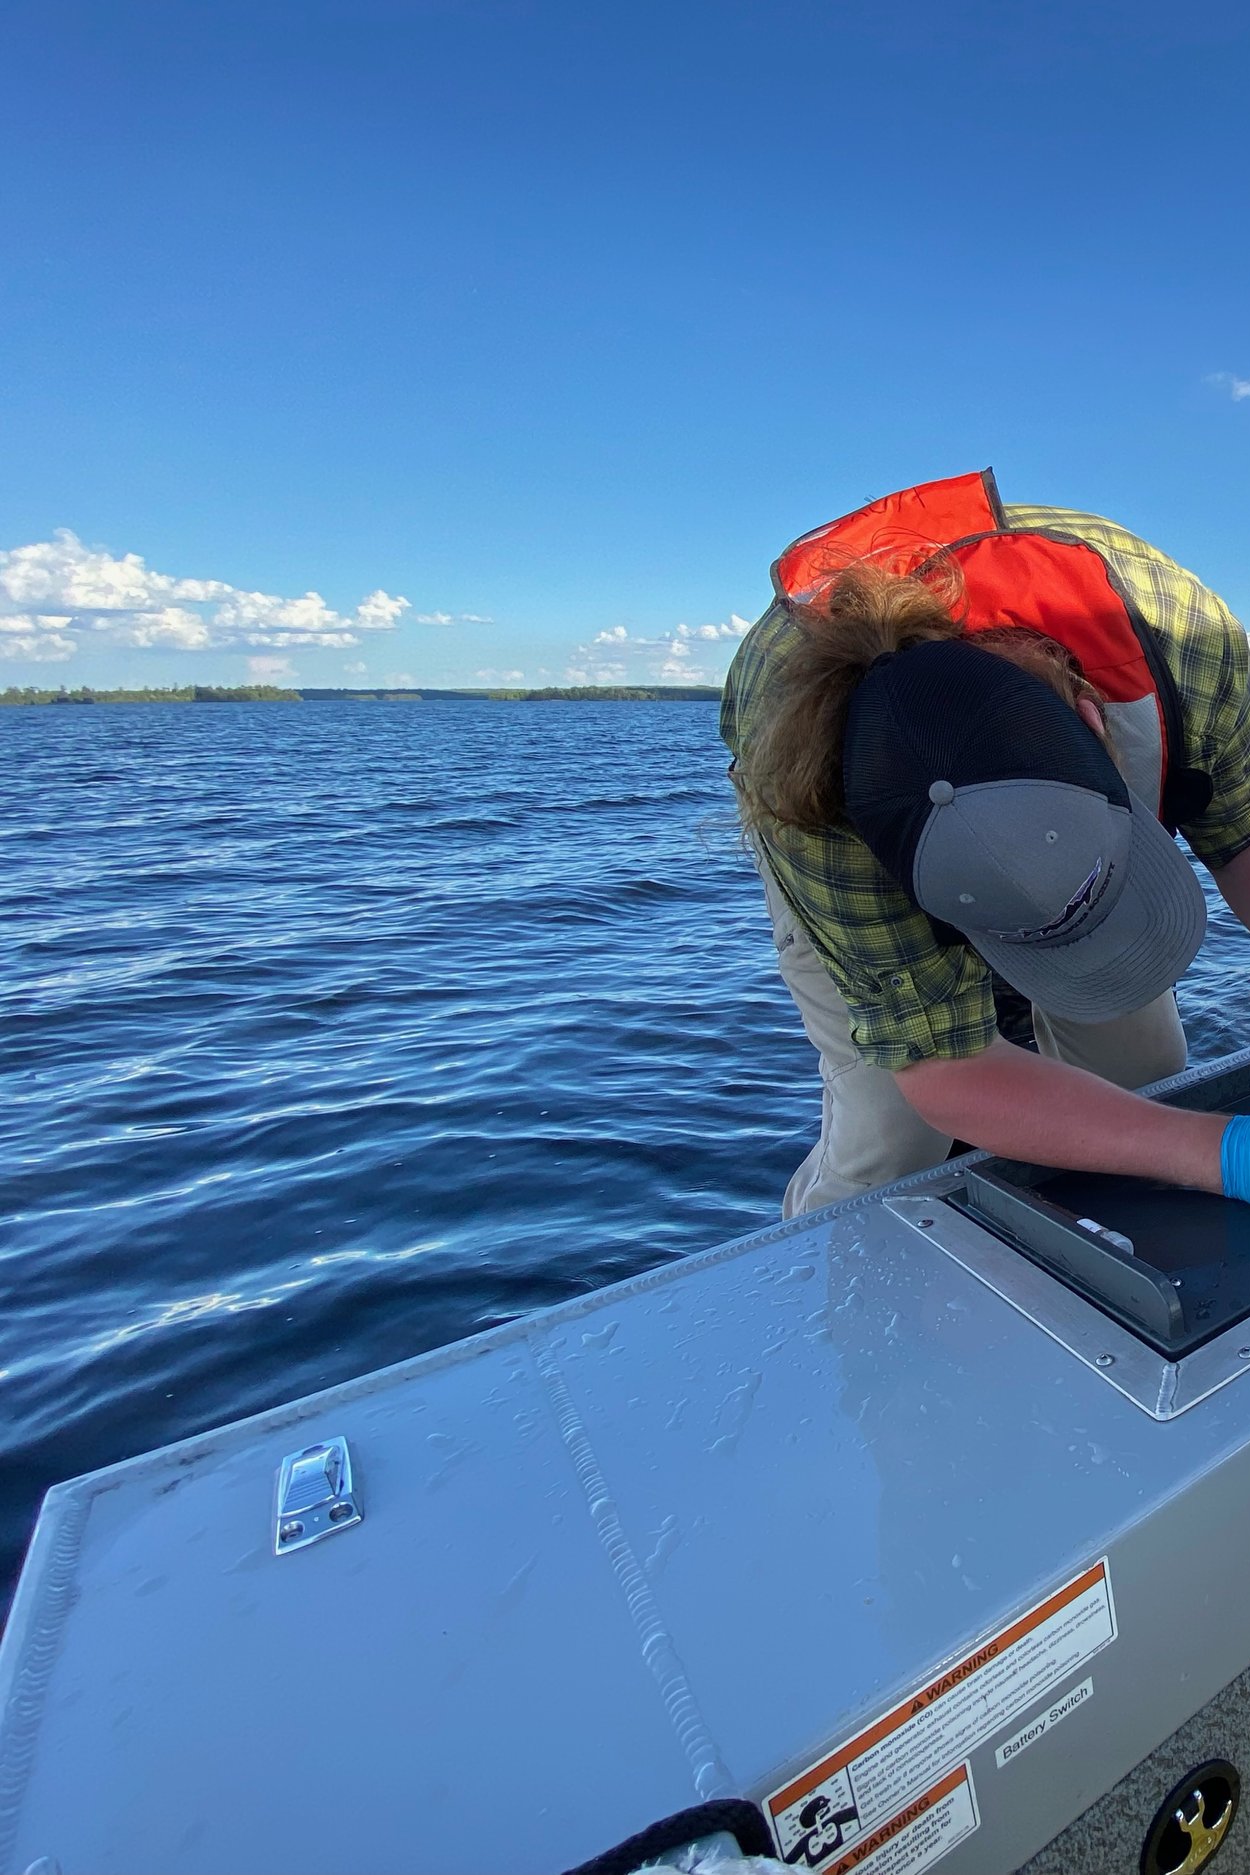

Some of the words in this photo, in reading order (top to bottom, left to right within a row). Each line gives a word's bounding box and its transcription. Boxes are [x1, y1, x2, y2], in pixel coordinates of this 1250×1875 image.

[854, 1762, 878, 1783] Engine
[894, 1727, 925, 1754] generator
[927, 1706, 951, 1729] exhaust
[953, 1688, 978, 1709] contains
[979, 1668, 1004, 1690] odorless
[1017, 1640, 1042, 1661] colorless
[1043, 1625, 1062, 1642] carbon
[1063, 1606, 1088, 1627] monoxide
[926, 1644, 999, 1700] WARNING
[851, 1749, 879, 1772] Carbon
[880, 1722, 915, 1751] monoxide
[916, 1708, 933, 1726] (CO)
[947, 1685, 965, 1702] cause
[967, 1673, 982, 1687] brain
[983, 1655, 1007, 1675] damage
[874, 1782, 891, 1799] fresh
[908, 1752, 932, 1773] anyone
[934, 1736, 953, 1754] shows
[955, 1723, 971, 1738] signs
[1001, 1679, 1028, 1703] monoxide
[877, 1784, 905, 1808] Owner's
[906, 1763, 930, 1786] Manual
[941, 1731, 975, 1760] information
[977, 1708, 1004, 1733] regarding
[1005, 1693, 1025, 1711] carbon
[1026, 1672, 1052, 1695] monoxide
[1003, 1720, 1046, 1760] Battery
[1049, 1687, 1088, 1723] Switch
[856, 1775, 876, 1793] Signs
[885, 1751, 908, 1771] carbon
[909, 1726, 940, 1753] monoxide
[941, 1704, 971, 1730] poisoning
[872, 1775, 886, 1789] lack
[853, 1797, 930, 1861] WARNING
[894, 1827, 930, 1858] resulting
[931, 1810, 950, 1828] from
[901, 1831, 910, 1841] or
[912, 1814, 935, 1833] death
[936, 1798, 954, 1814] from
[910, 1829, 939, 1854] system
[940, 1818, 952, 1829] for
[895, 1857, 916, 1875] once
